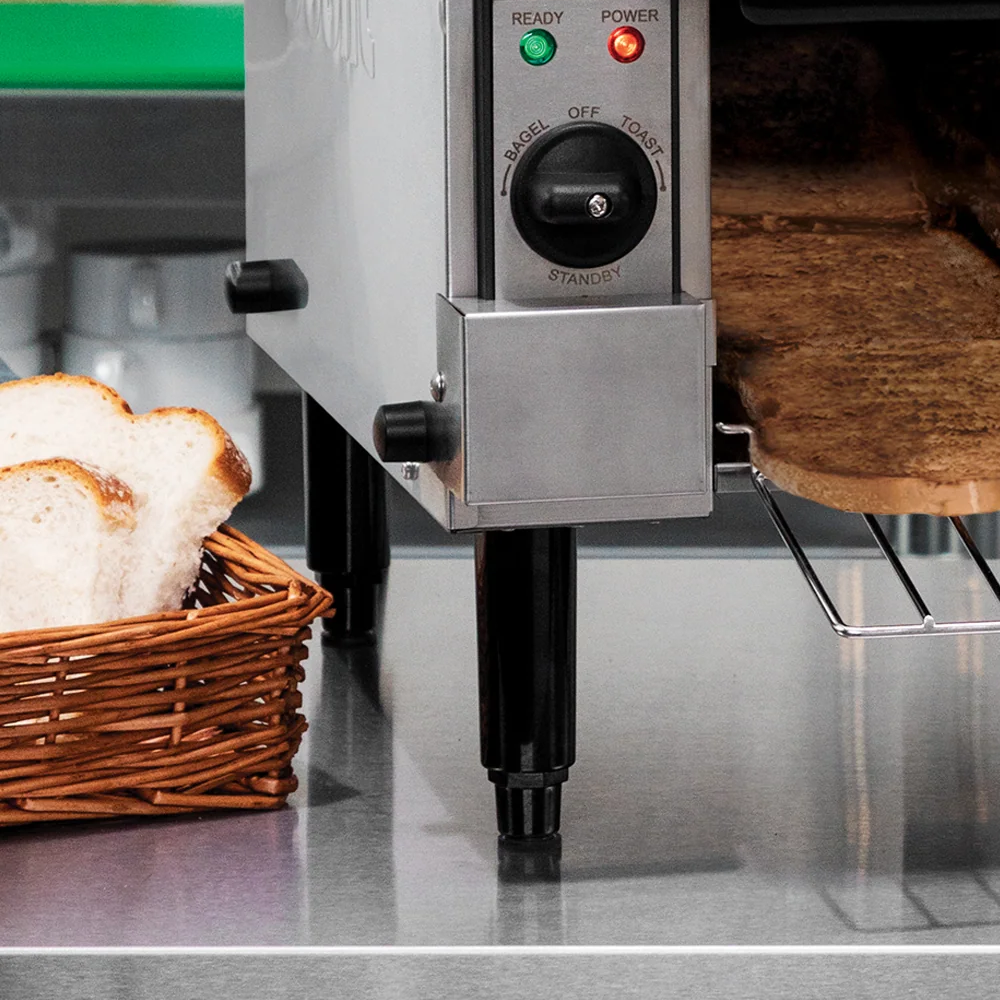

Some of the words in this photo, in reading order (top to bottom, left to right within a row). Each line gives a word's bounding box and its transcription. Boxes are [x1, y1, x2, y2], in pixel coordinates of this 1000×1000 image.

[512, 11, 564, 25] READY
[601, 9, 659, 23] POWER
[568, 106, 600, 119] OFF
[504, 119, 549, 162] BAGEL
[621, 115, 664, 157] TOAST
[548, 266, 621, 285] STANDBY
